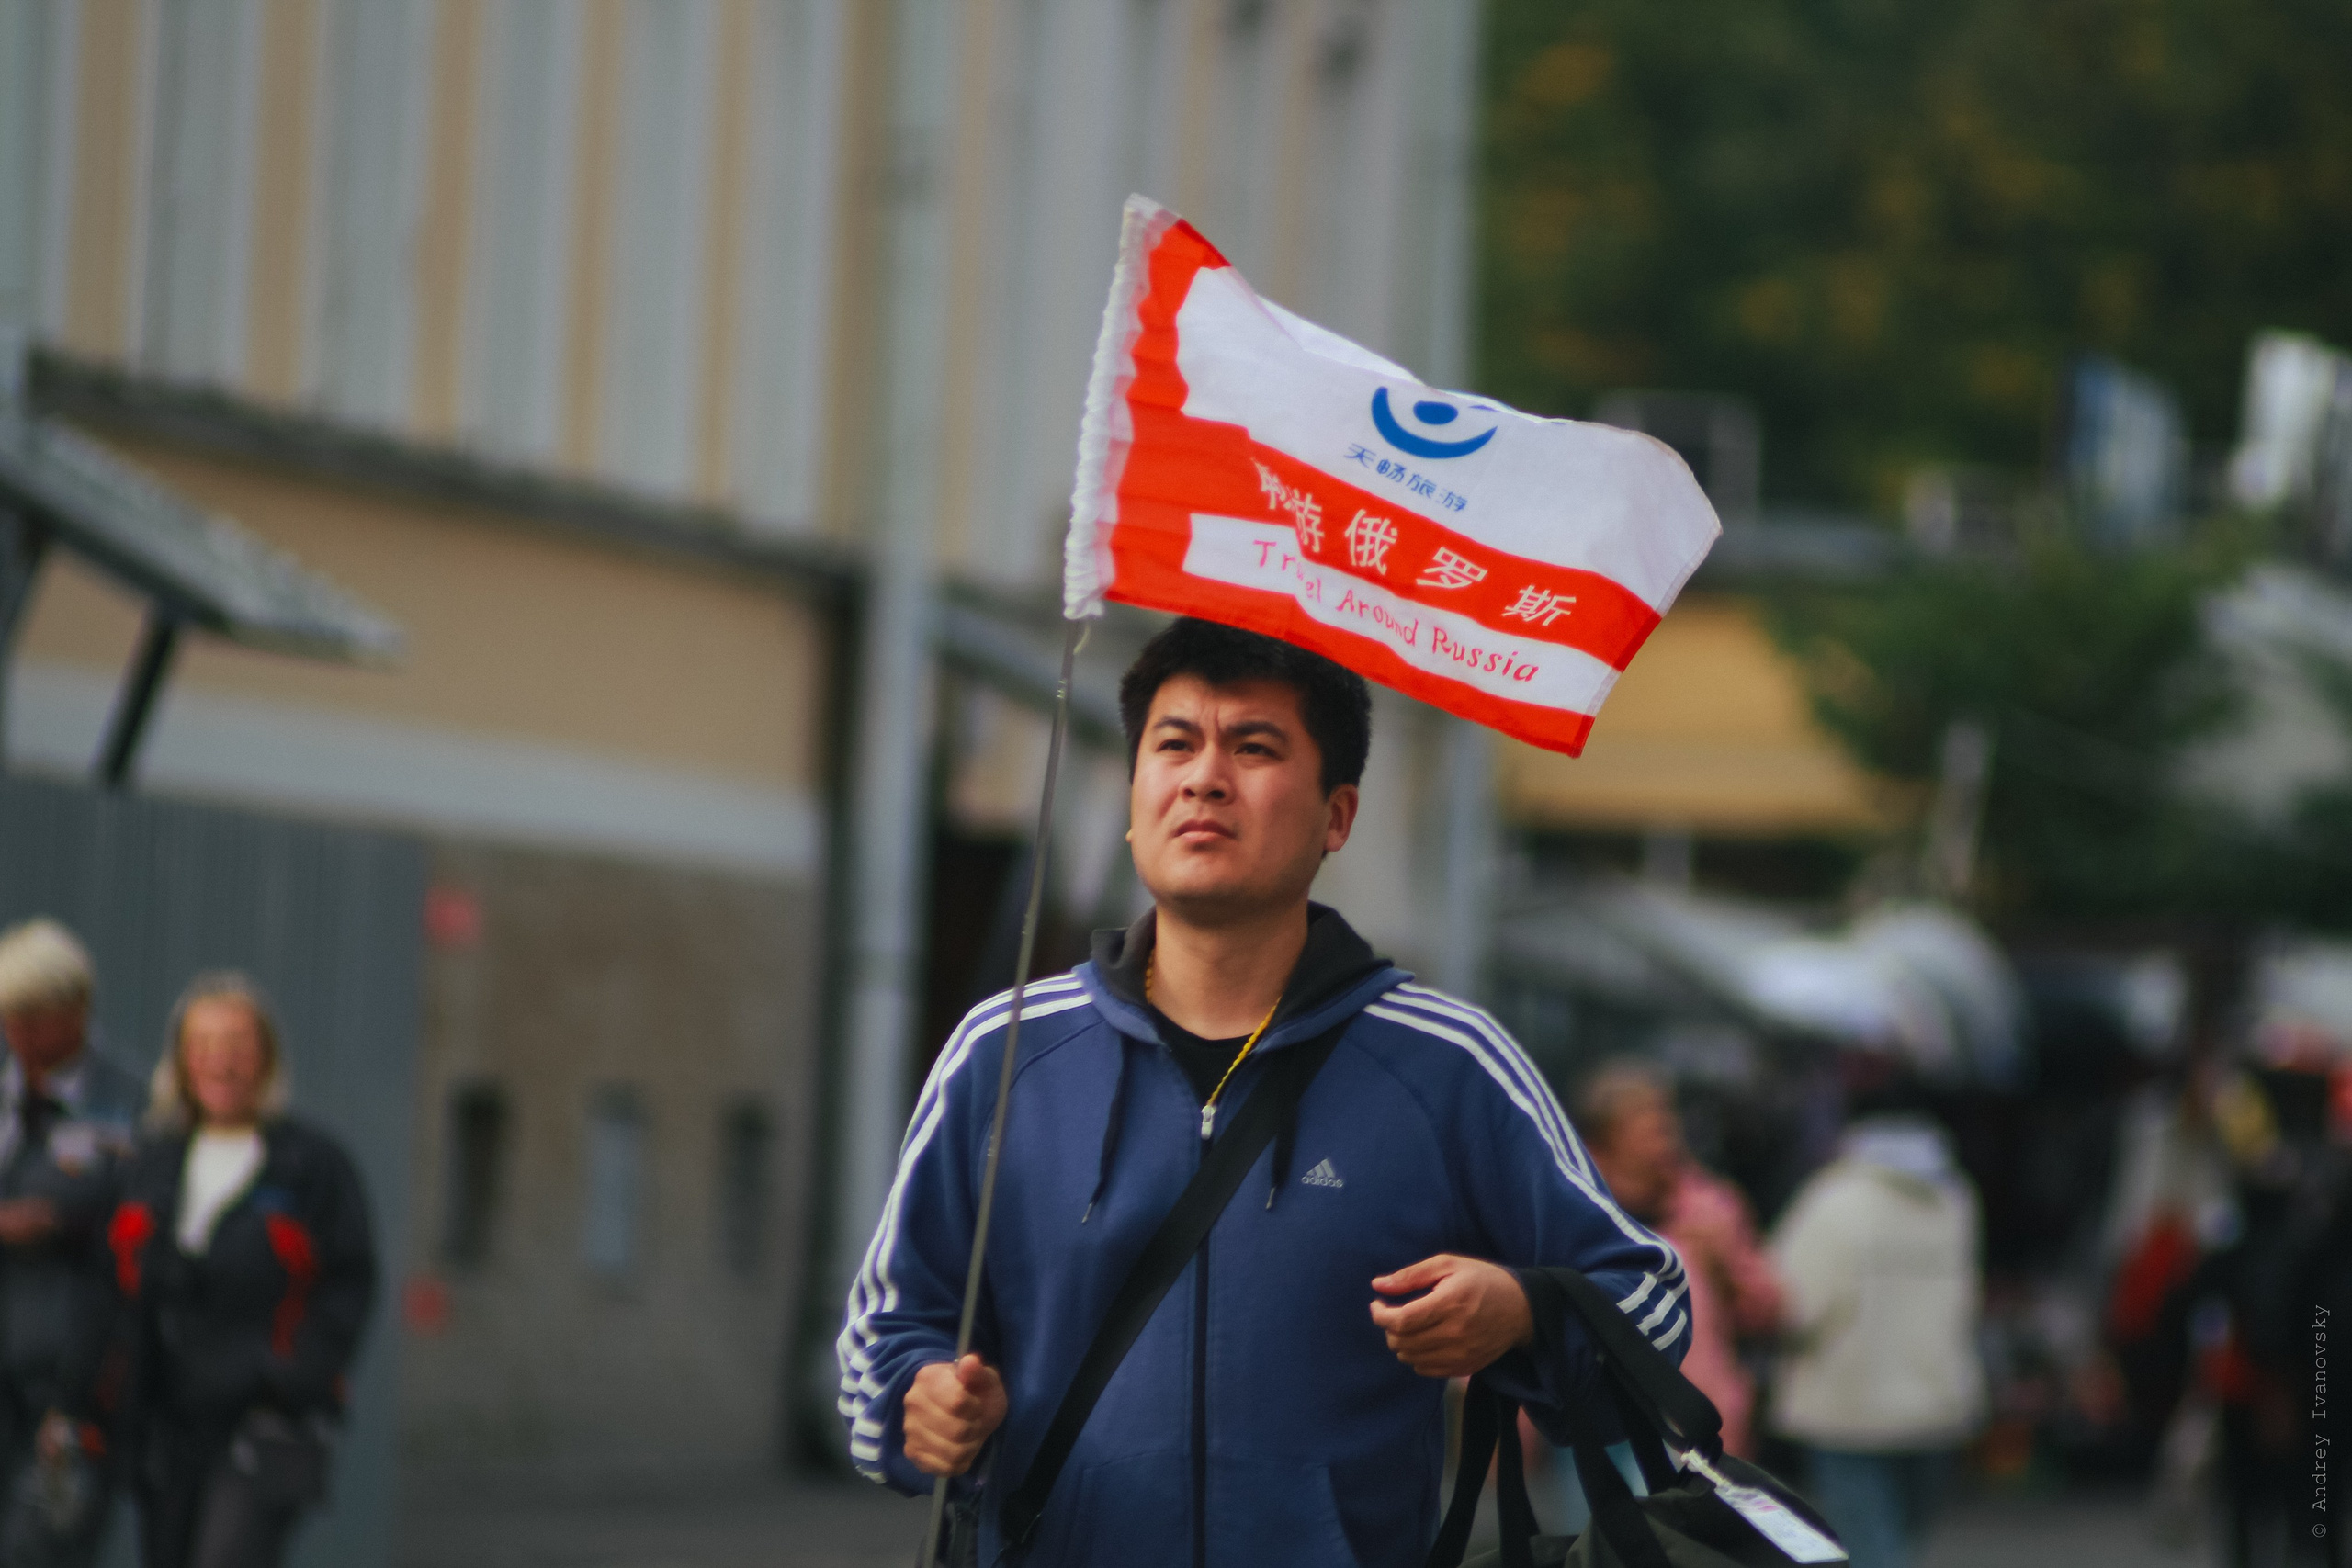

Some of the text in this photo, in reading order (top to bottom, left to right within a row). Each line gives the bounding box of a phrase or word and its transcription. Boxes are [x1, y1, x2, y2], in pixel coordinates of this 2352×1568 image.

[1343, 442, 1468, 512] 天畅旅游
[1335, 588, 1419, 647] Around
[1431, 626, 1540, 682] Russia
[1301, 1176, 1343, 1188] adidas
